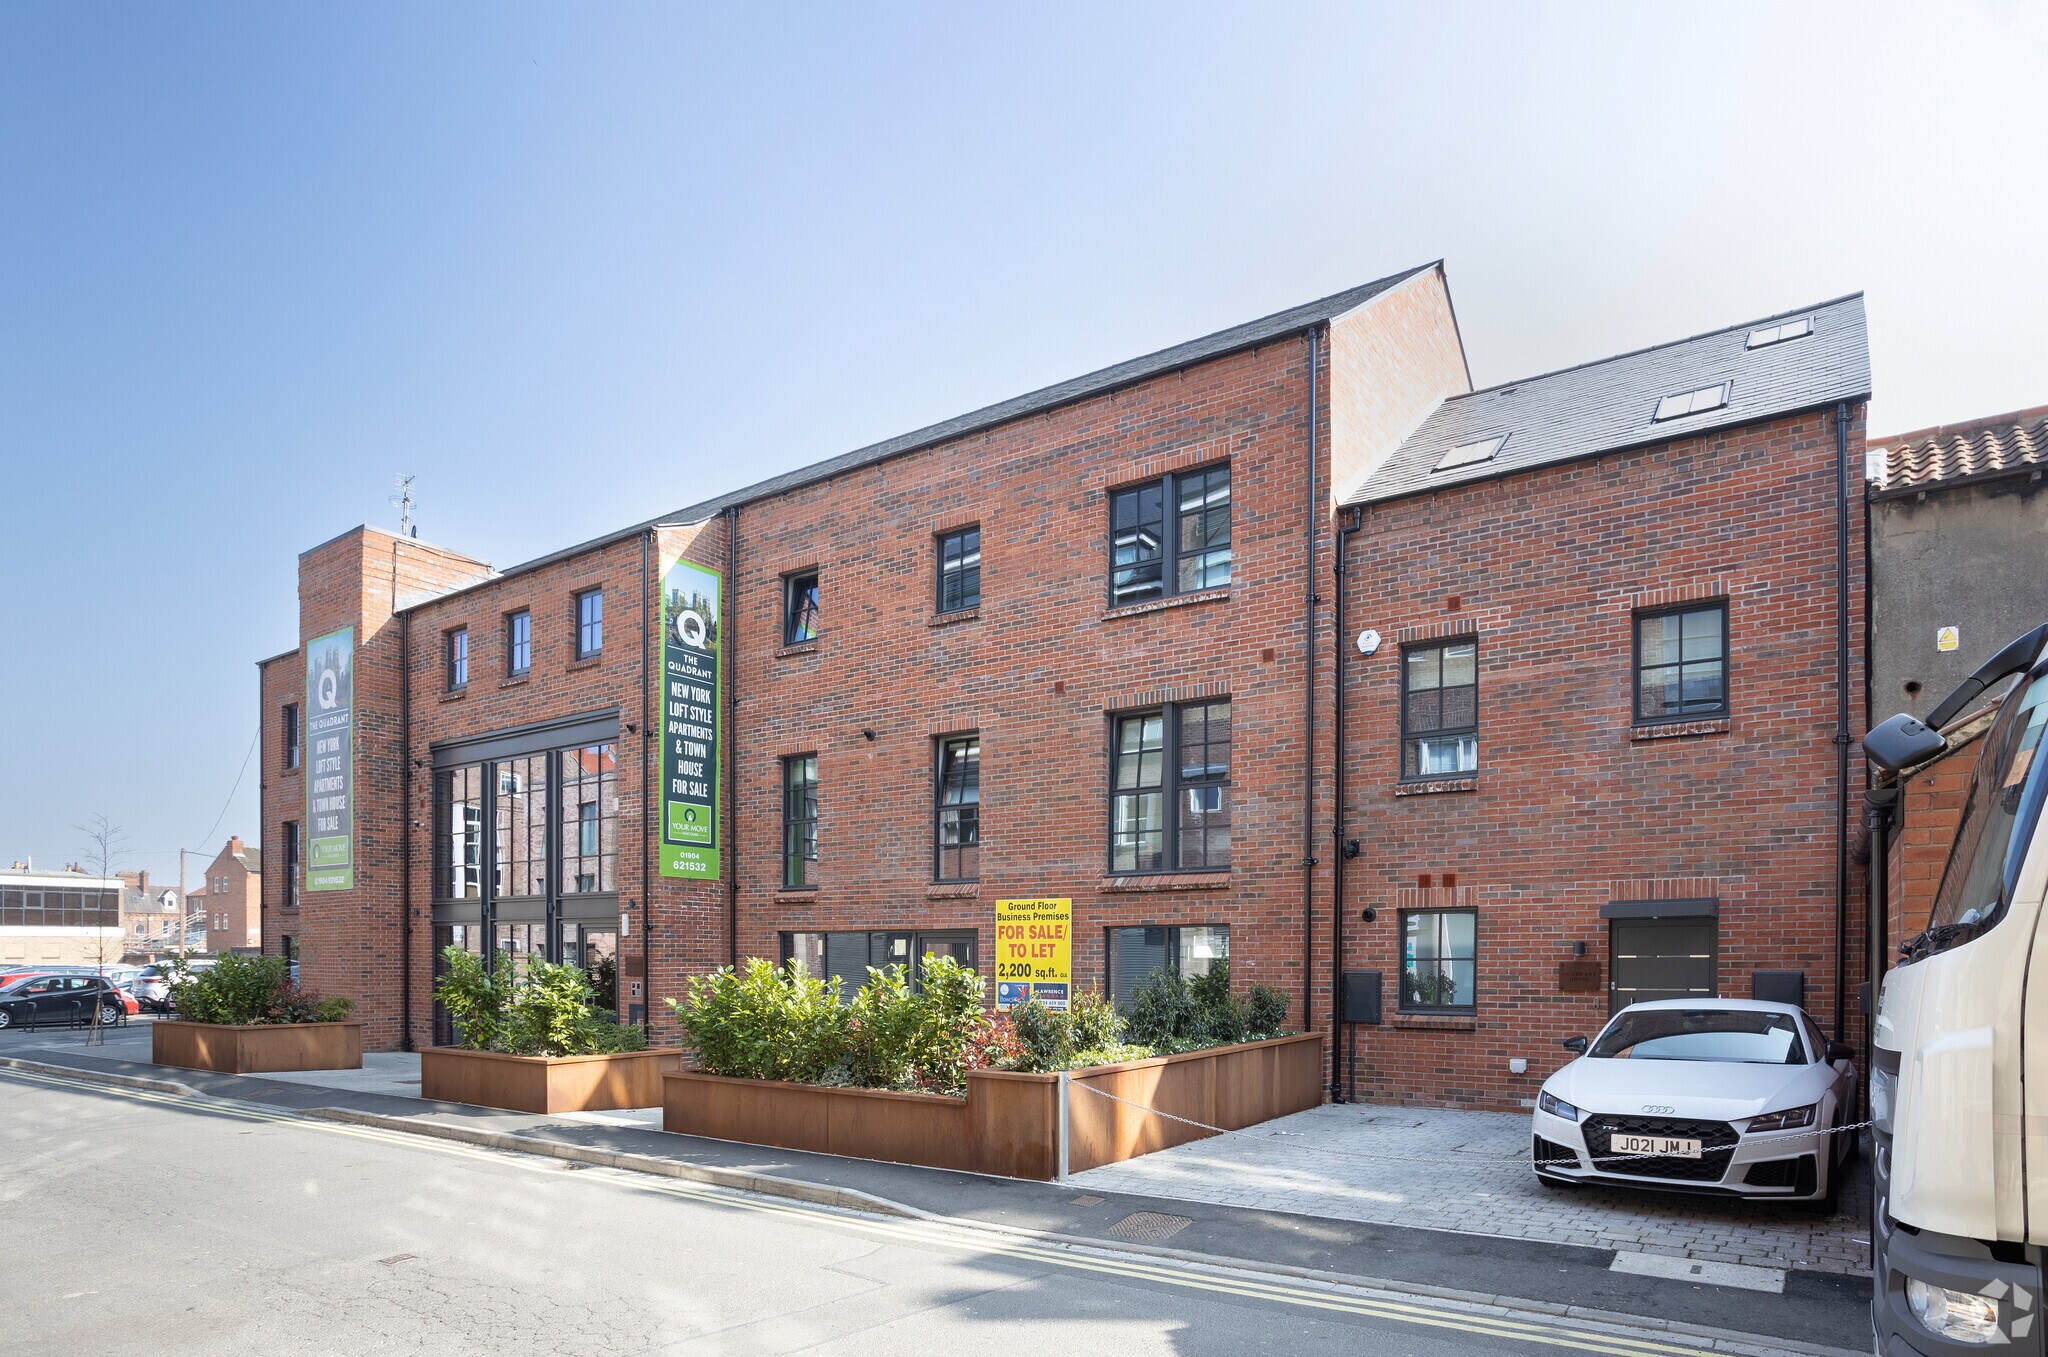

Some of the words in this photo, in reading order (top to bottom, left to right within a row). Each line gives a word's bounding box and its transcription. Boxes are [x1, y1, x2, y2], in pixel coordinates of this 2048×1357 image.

[677, 610, 706, 649] Q
[683, 654, 698, 666] THE
[668, 661, 712, 679] QUADRANT
[318, 668, 337, 710] Q
[671, 681, 689, 699] NEW
[691, 686, 711, 704] YORK
[669, 701, 688, 718] LOFT
[690, 706, 712, 724] STYLE
[309, 721, 318, 731] THE
[319, 713, 349, 729] QUADRANT
[668, 720, 713, 740] APARTMENTS
[316, 739, 326, 754] NEW
[327, 736, 339, 752] YORK
[675, 739, 682, 754] &
[684, 740, 706, 758] TOWN
[315, 759, 326, 774] LOFT
[326, 756, 340, 772] STYLE
[678, 759, 703, 777] HOUSE
[313, 775, 343, 794] APARTMENTS
[672, 779, 687, 794] FOR
[689, 781, 707, 797] SALE
[317, 798, 328, 812] TOWN
[329, 795, 345, 810] HOUSE
[317, 817, 326, 831] FOR
[326, 815, 338, 830] SALE
[672, 823, 689, 831] YOUR
[680, 851, 699, 859] 01904
[673, 861, 706, 871] 621532
[1008, 902, 1035, 910] Ground
[997, 913, 1030, 921] Business
[1033, 912, 1069, 920] Premises
[998, 925, 1024, 939] FOR
[1008, 943, 1027, 958] TO
[1031, 943, 1056, 958] LET
[998, 963, 1031, 979] 2,200
[1035, 967, 1058, 980] sq.ft.
